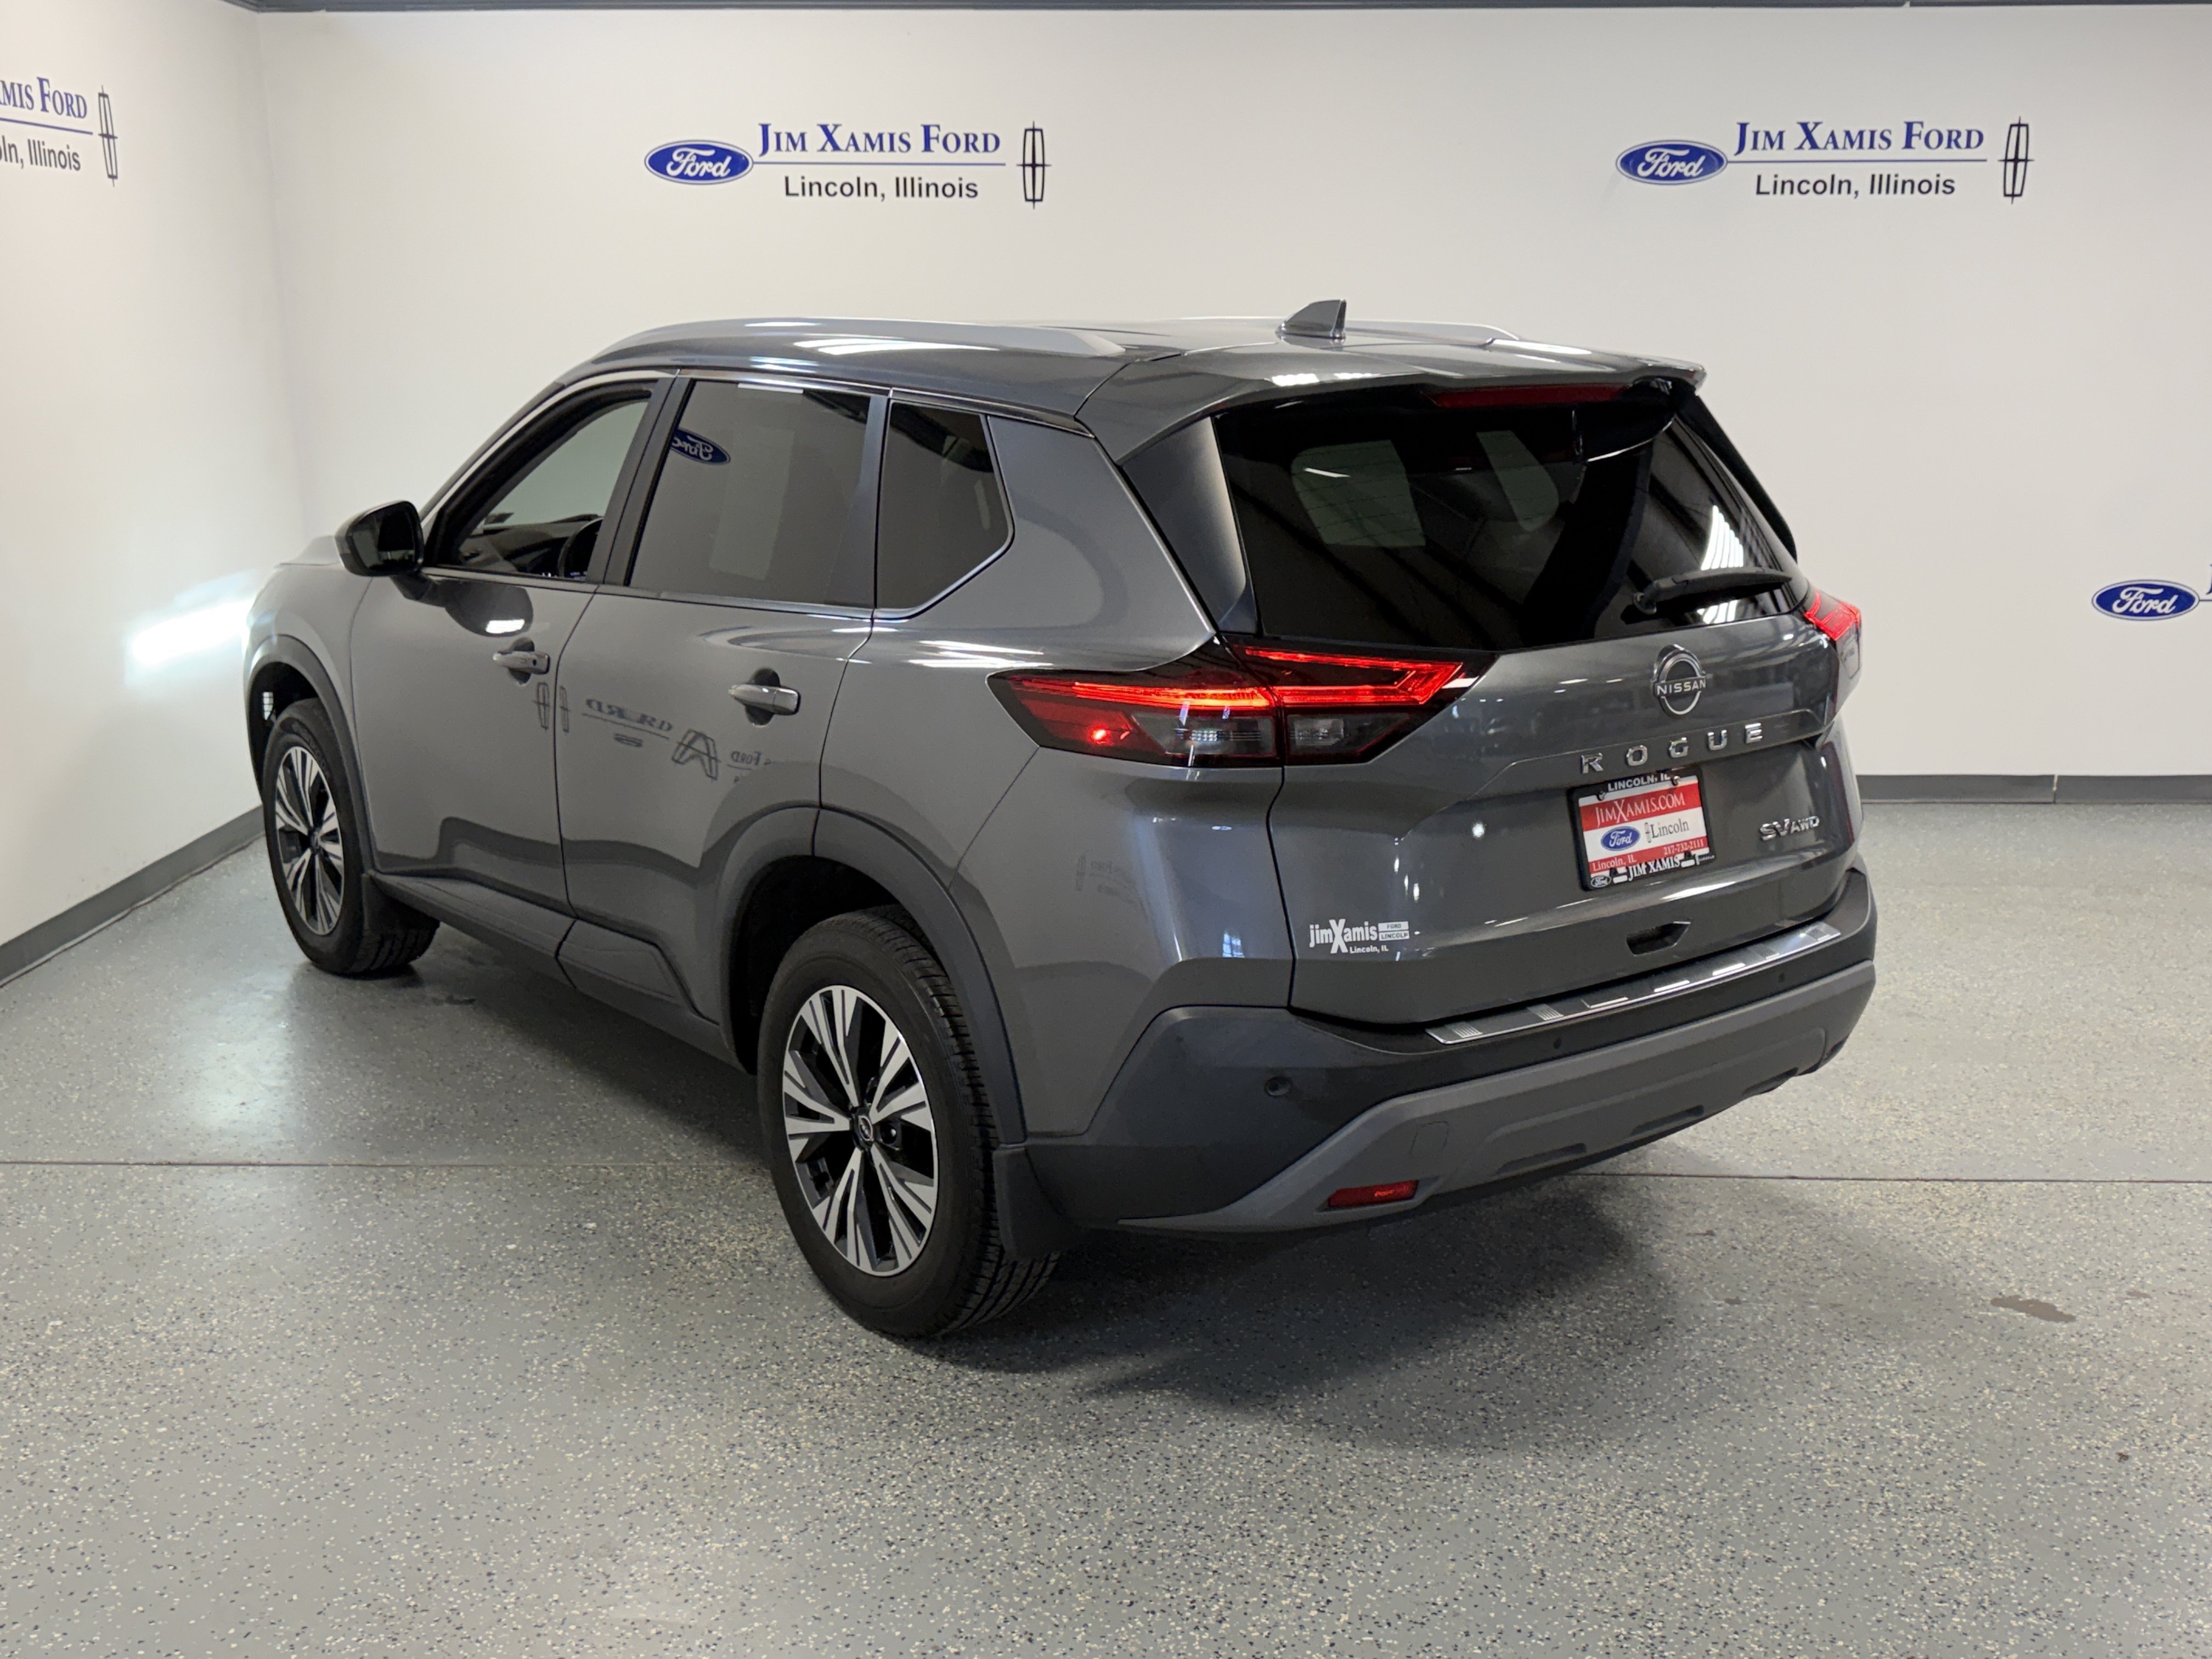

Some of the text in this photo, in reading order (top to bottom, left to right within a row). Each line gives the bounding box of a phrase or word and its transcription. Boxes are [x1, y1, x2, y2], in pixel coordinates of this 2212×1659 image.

[37, 77, 87, 119] FORD
[759, 123, 1000, 157] JIM XAMIS FORD
[1734, 121, 1983, 156] JIM XAMIS FORD
[27, 139, 81, 171] Illinois
[666, 149, 731, 177] Ford
[1637, 149, 1703, 177] Ford
[785, 176, 978, 201] Lincoln, Illinois
[1756, 173, 1955, 199] Lincoln, Illinois
[2112, 586, 2179, 614] Ford
[1657, 679, 1707, 696] NISSAN
[1581, 723, 1763, 774] ROGUE
[1607, 774, 1657, 792] LINCOLN,
[1595, 792, 1686, 827] JIMXAMIS.COM
[1609, 830, 1633, 847] Ford
[1650, 818, 1689, 838] Lincoln
[1593, 854, 1637, 871] Lincoln, IL
[1628, 865, 1646, 881] JIM
[1649, 856, 1681, 873] XAMIS
[1350, 945, 1380, 953] Lincoln,
